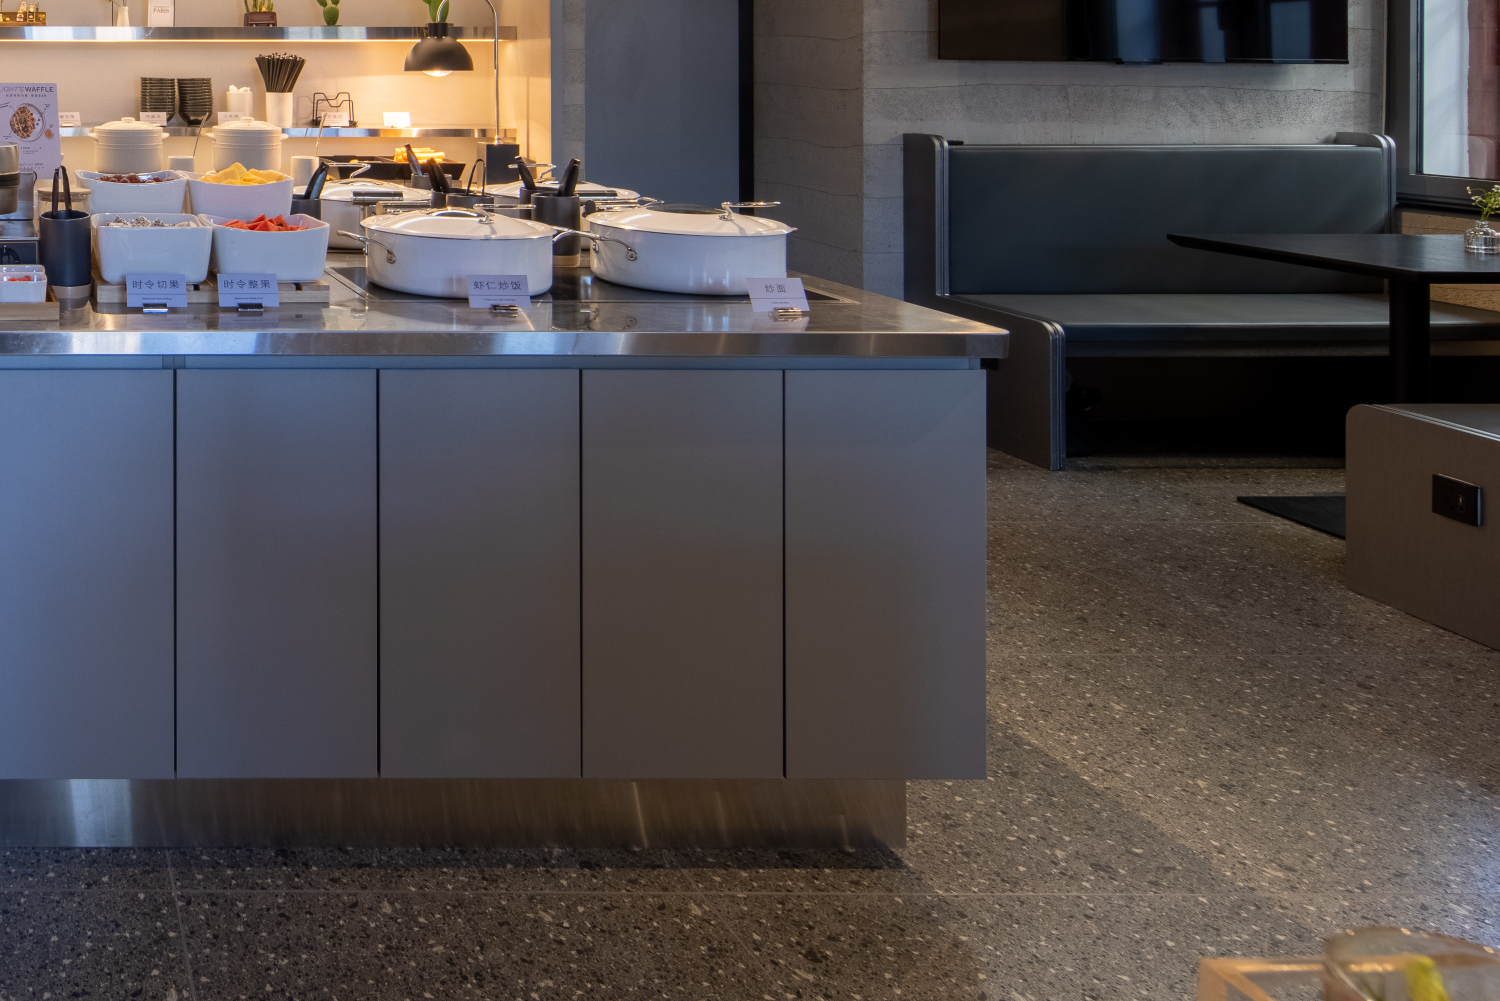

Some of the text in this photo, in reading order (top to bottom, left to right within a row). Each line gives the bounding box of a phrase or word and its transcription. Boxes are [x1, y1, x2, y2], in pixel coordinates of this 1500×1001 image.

[132, 279, 180, 290] 时令切果
[224, 279, 271, 289] 时令整果
[474, 281, 522, 290] 虾仁炒饭
[764, 284, 786, 293] 炒面
